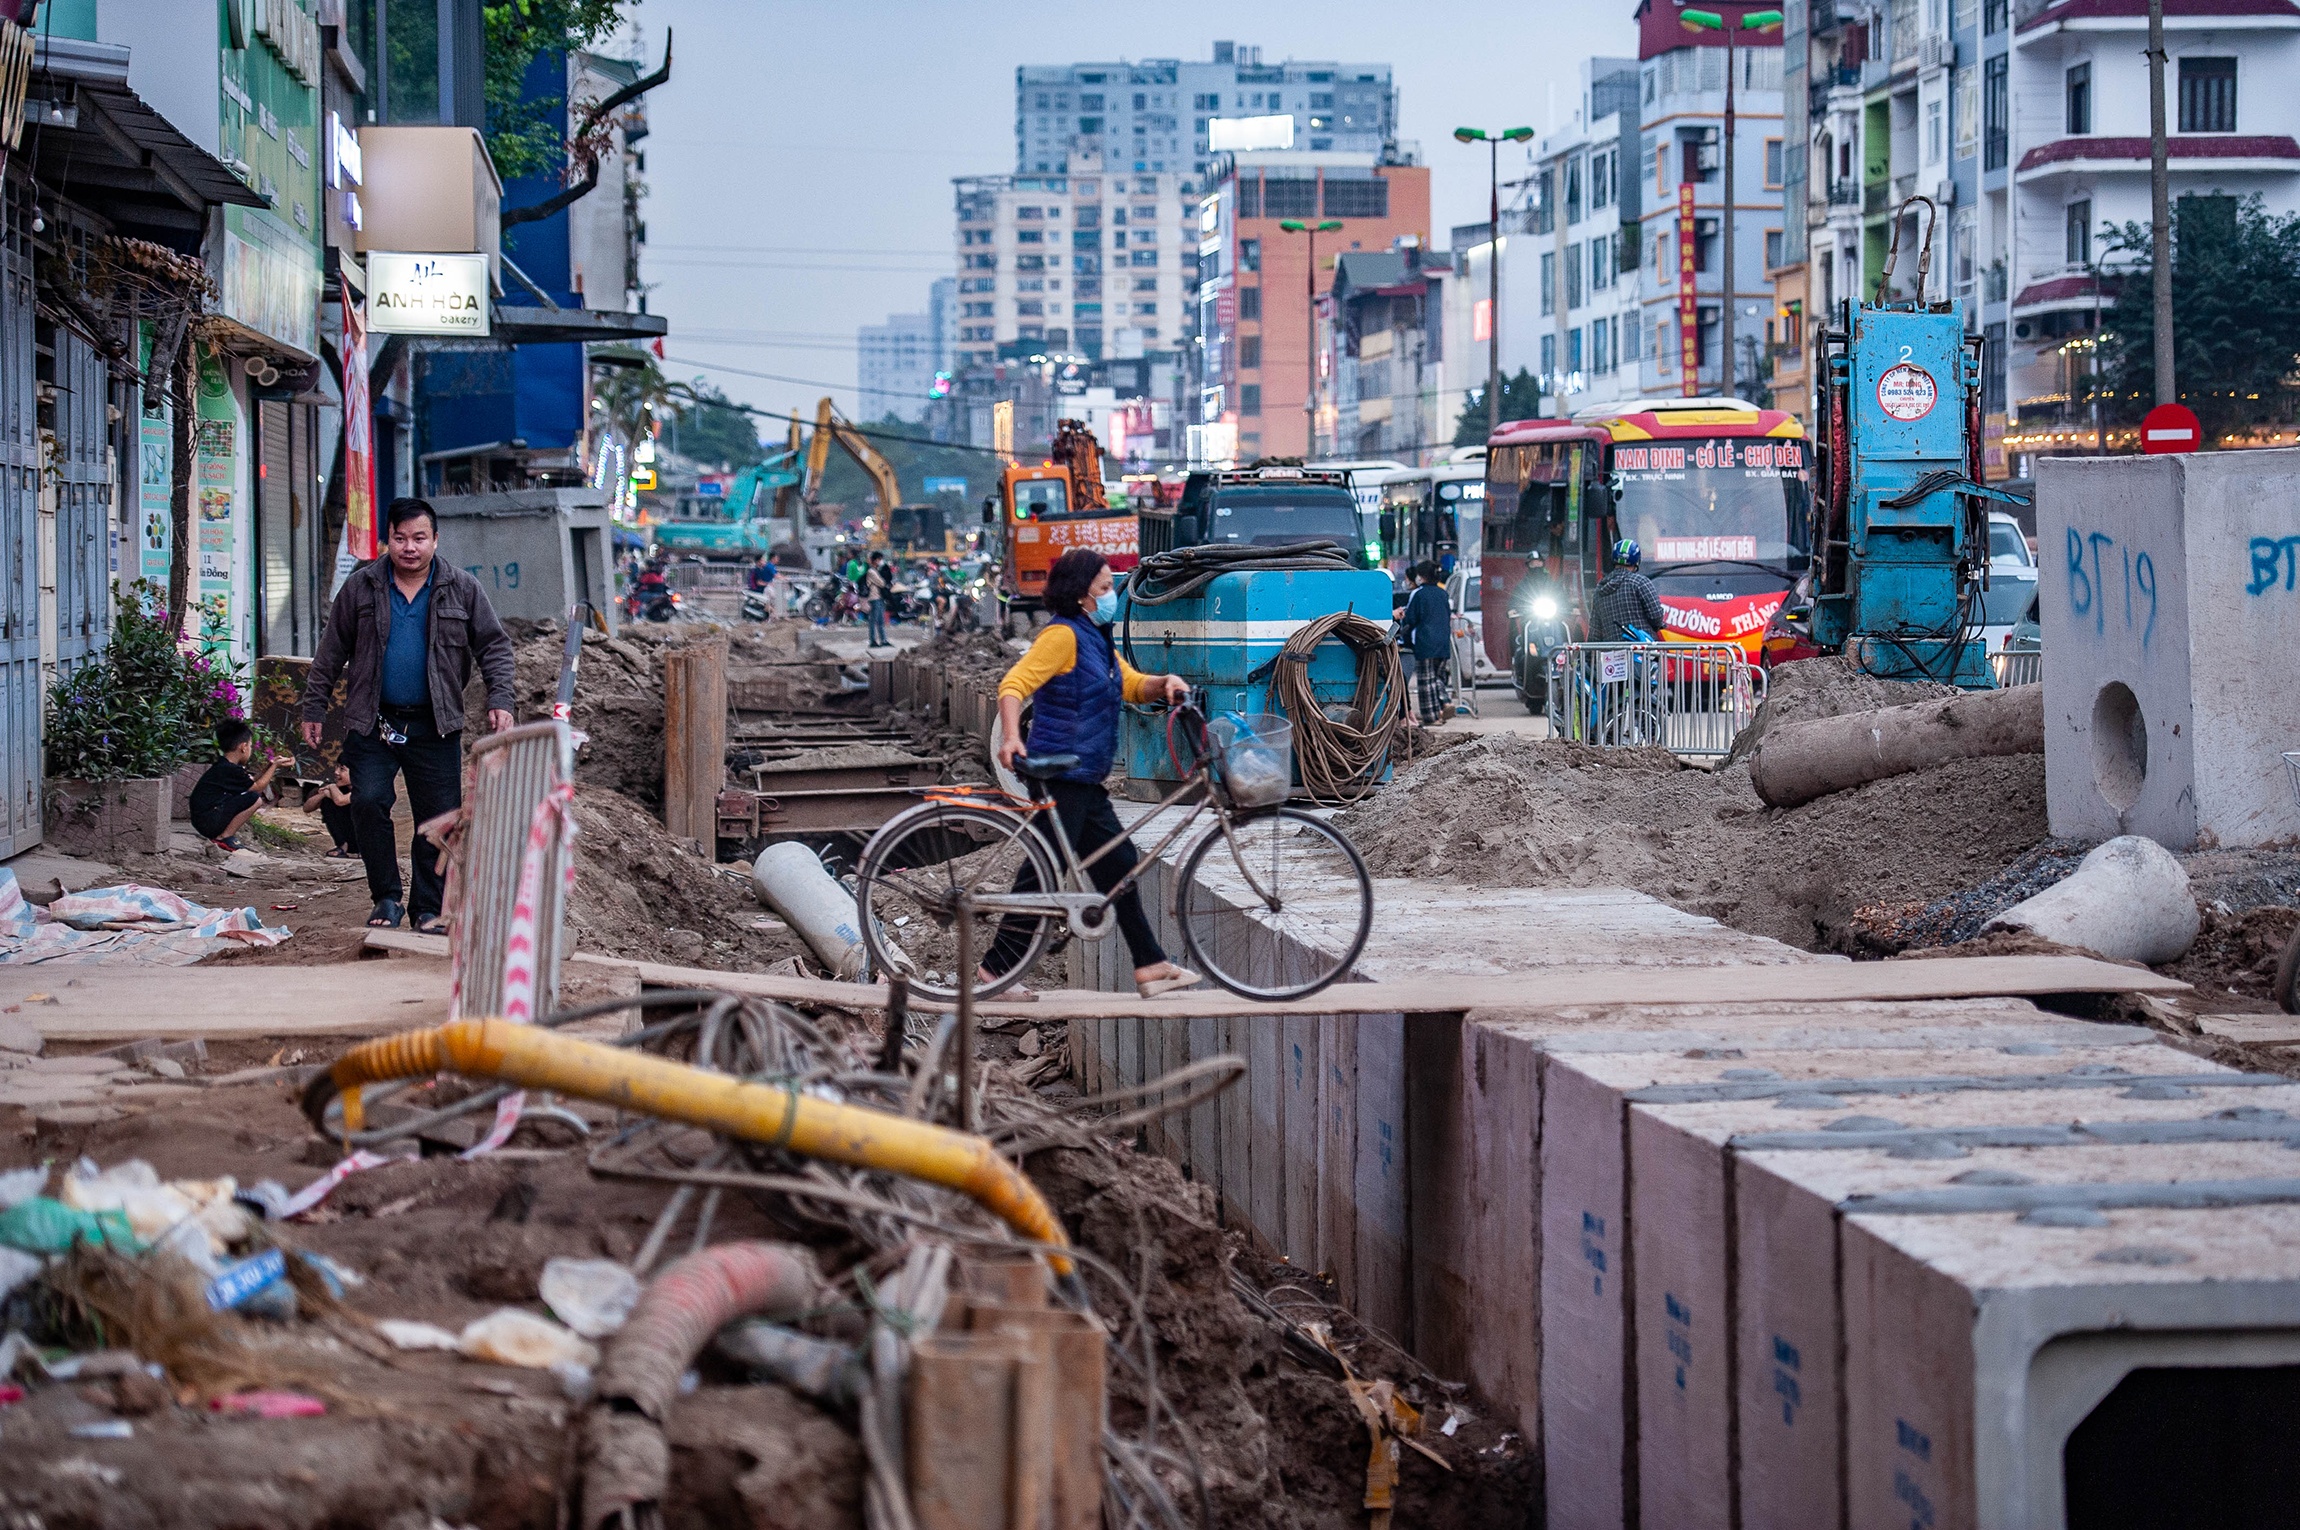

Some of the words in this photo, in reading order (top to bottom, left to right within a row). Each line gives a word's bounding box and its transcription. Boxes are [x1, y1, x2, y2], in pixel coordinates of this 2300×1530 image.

[376, 291, 424, 308] ANH
[432, 291, 480, 311] HÒA
[440, 314, 479, 327] bakery
[1899, 345, 1913, 364] 2
[1614, 447, 1648, 470] NAM
[1650, 447, 1685, 474] ĐỊNH
[1744, 443, 1773, 471] CHỢ
[1664, 472, 1686, 481] NINH
[1657, 541, 1675, 560] NAM
[491, 561, 519, 590] 19
[2066, 525, 2113, 637] BT
[2122, 545, 2156, 652] 19
[1214, 596, 1222, 615] 2
[1660, 603, 1721, 636] TRƯỜNG
